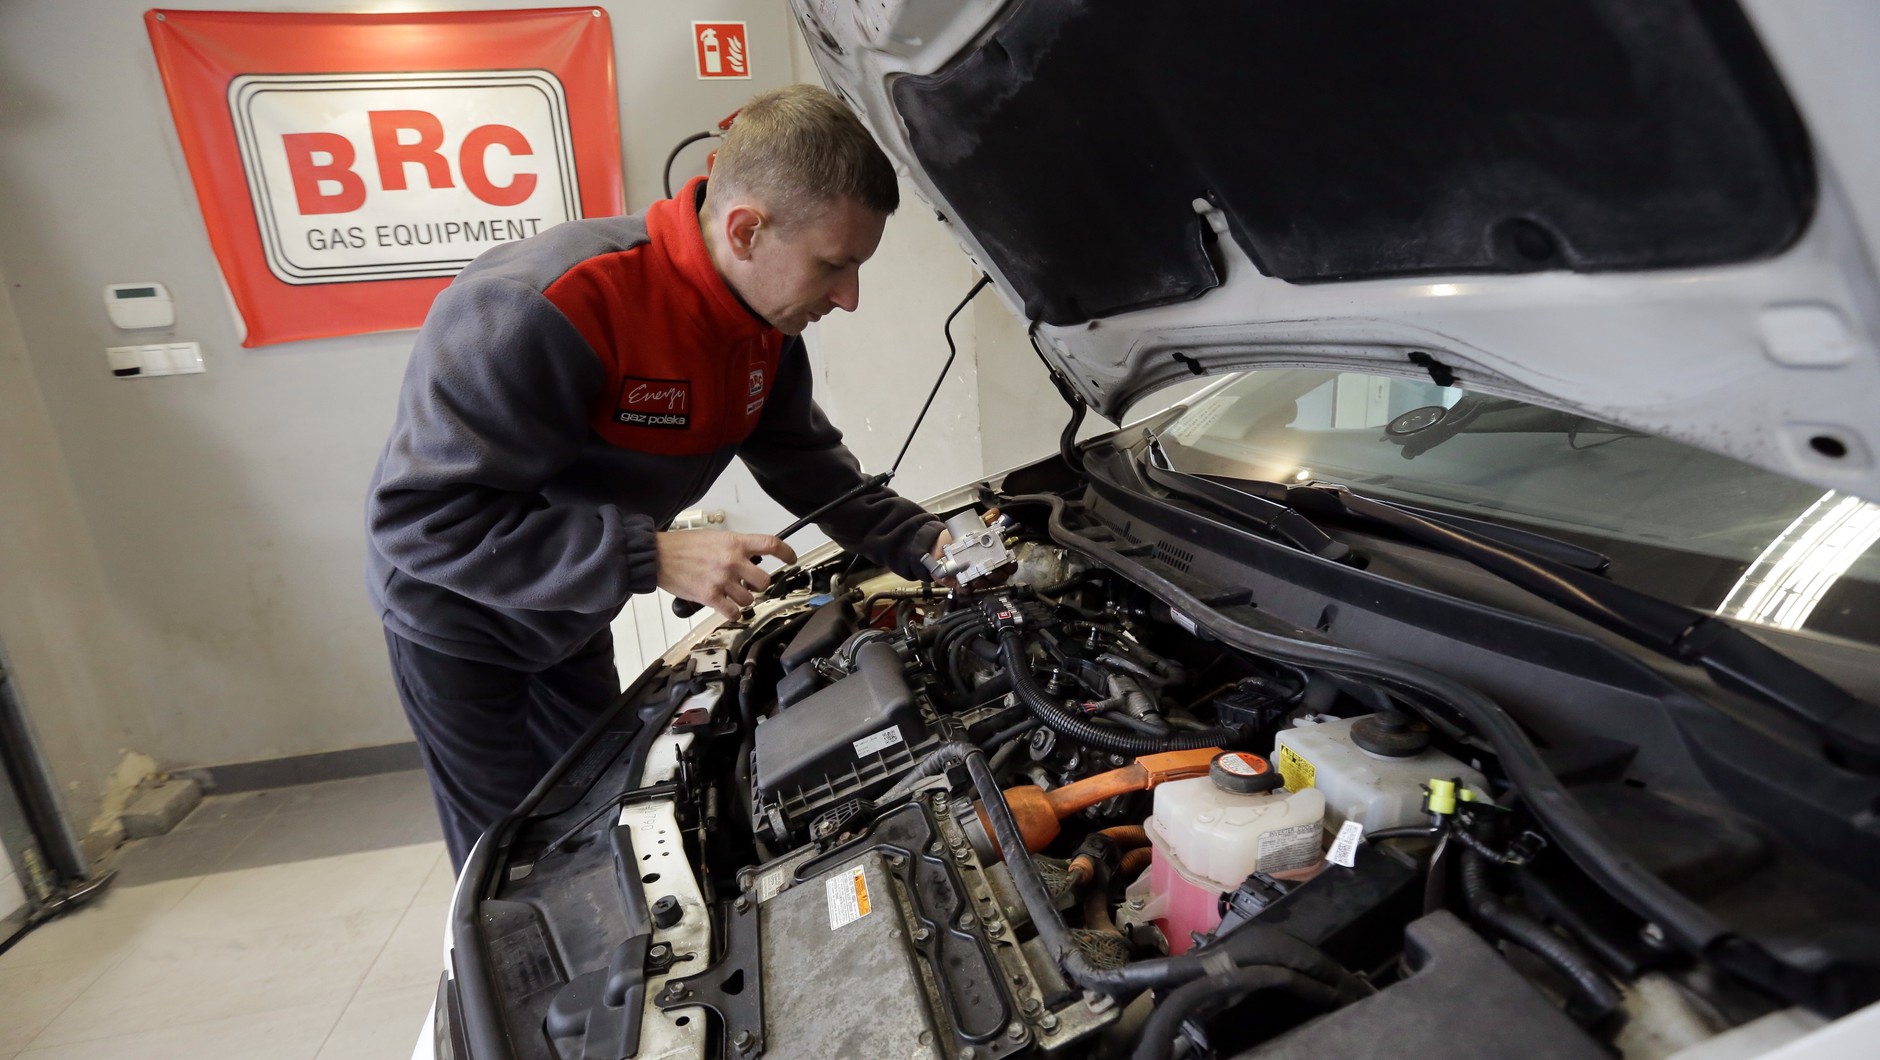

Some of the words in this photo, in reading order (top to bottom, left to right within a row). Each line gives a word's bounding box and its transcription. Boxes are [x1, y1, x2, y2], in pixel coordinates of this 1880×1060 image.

[281, 109, 538, 216] BRC
[306, 226, 366, 251] GAS
[376, 217, 541, 247] EQUIPMENT
[628, 383, 685, 410] Energy
[620, 412, 647, 422] gaz
[648, 415, 685, 425] polska
